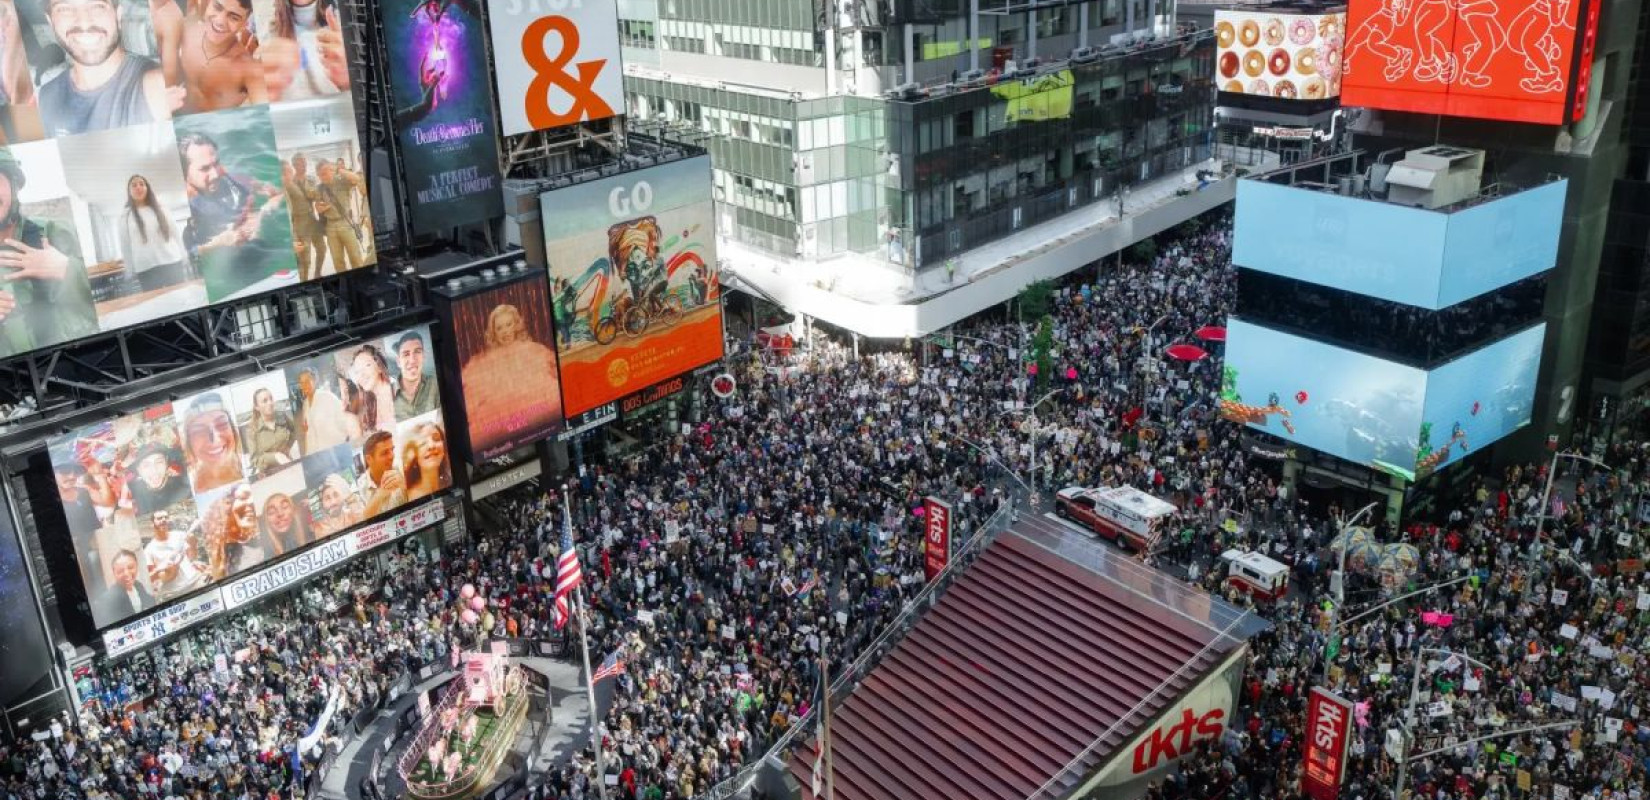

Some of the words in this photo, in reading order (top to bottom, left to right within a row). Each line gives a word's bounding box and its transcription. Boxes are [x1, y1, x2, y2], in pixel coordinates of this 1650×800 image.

[608, 180, 653, 217] GO
[930, 505, 945, 543] tkts
[123, 617, 151, 632] SPORTS
[1132, 707, 1224, 773] tkts
[1315, 700, 1342, 749] tkts
